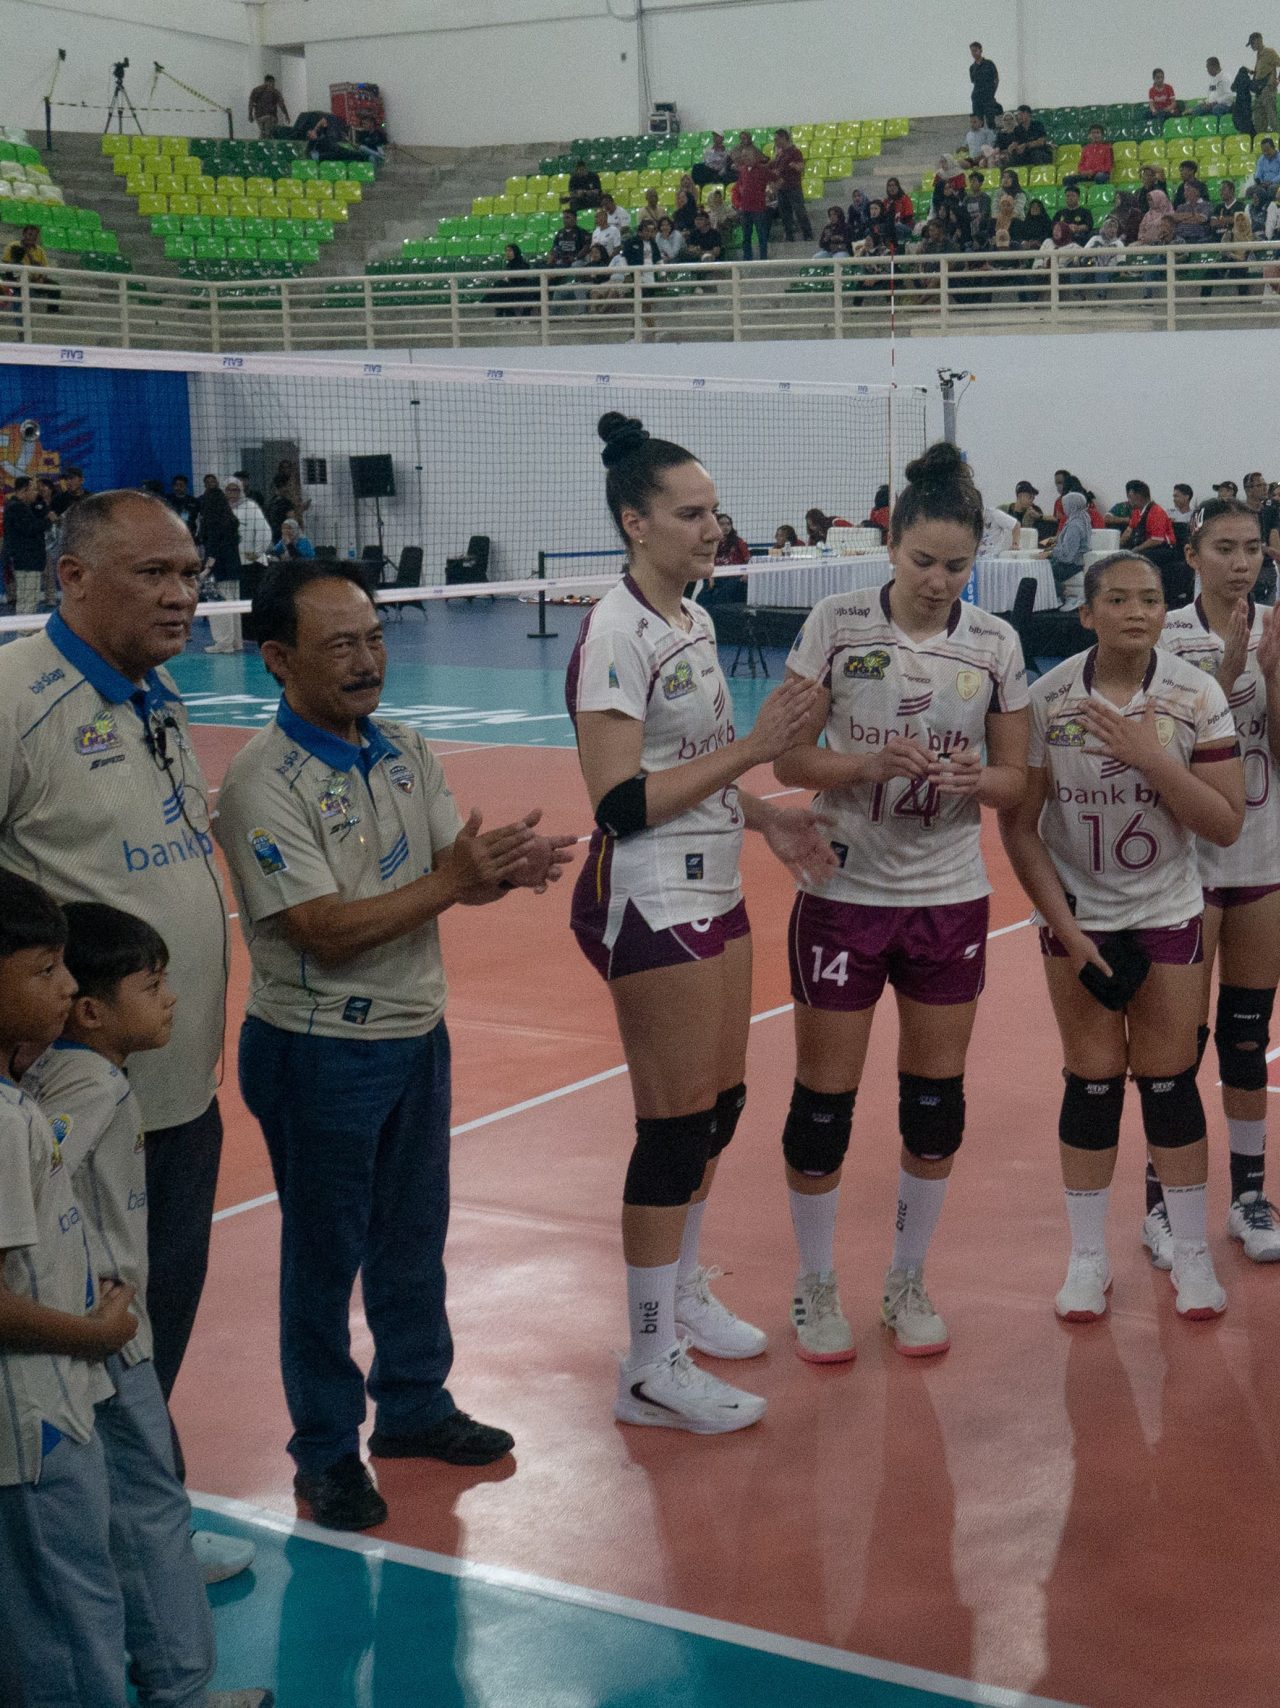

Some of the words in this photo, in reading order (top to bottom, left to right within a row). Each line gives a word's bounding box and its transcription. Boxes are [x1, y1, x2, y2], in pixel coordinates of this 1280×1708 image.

[61, 349, 84, 360] FIVB
[222, 357, 243, 367] FIVB
[363, 363, 382, 373] FIVB
[487, 369, 504, 378] FIVB
[848, 606, 871, 618] siap
[1058, 683, 1073, 696] sia
[870, 774, 941, 830] 14
[1056, 780, 1126, 805] bank
[123, 828, 200, 872] bank
[1079, 810, 1161, 876] 16
[811, 945, 849, 987] 14
[127, 1189, 146, 1211] ba
[59, 1205, 80, 1234] ba
